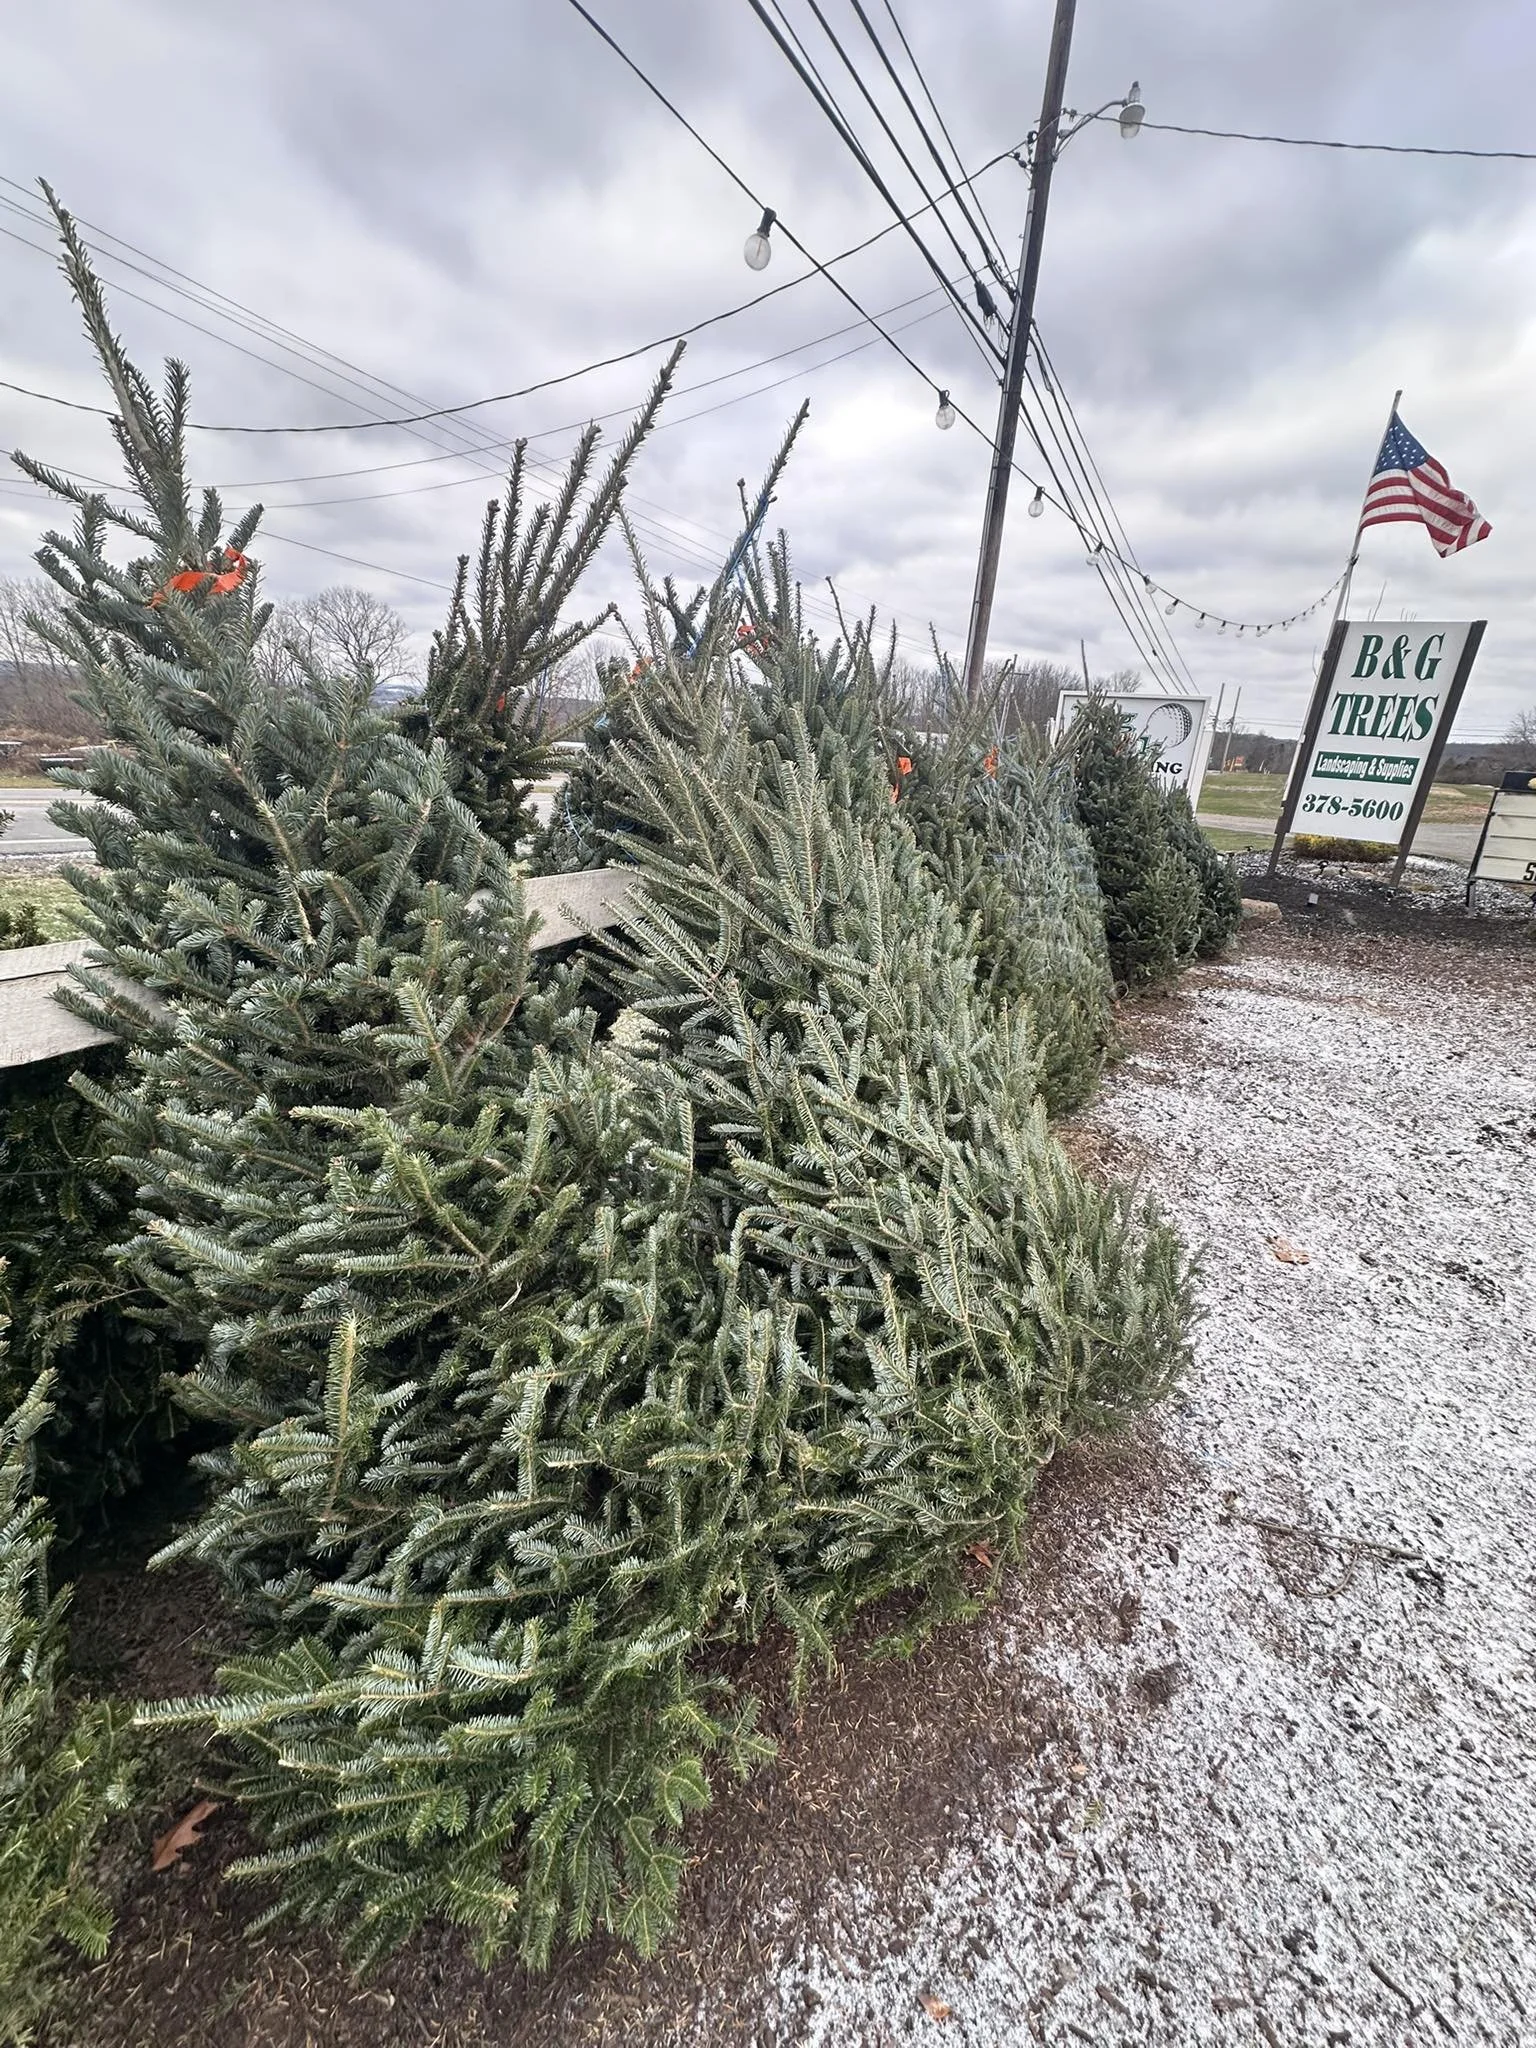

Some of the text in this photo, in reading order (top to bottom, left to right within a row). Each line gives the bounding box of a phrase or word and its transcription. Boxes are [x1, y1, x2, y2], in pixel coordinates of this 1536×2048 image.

[1327, 691, 1440, 742] TREES
[1316, 754, 1414, 781] Landscaping & Supplies
[1302, 793, 1404, 821] 378-5600
